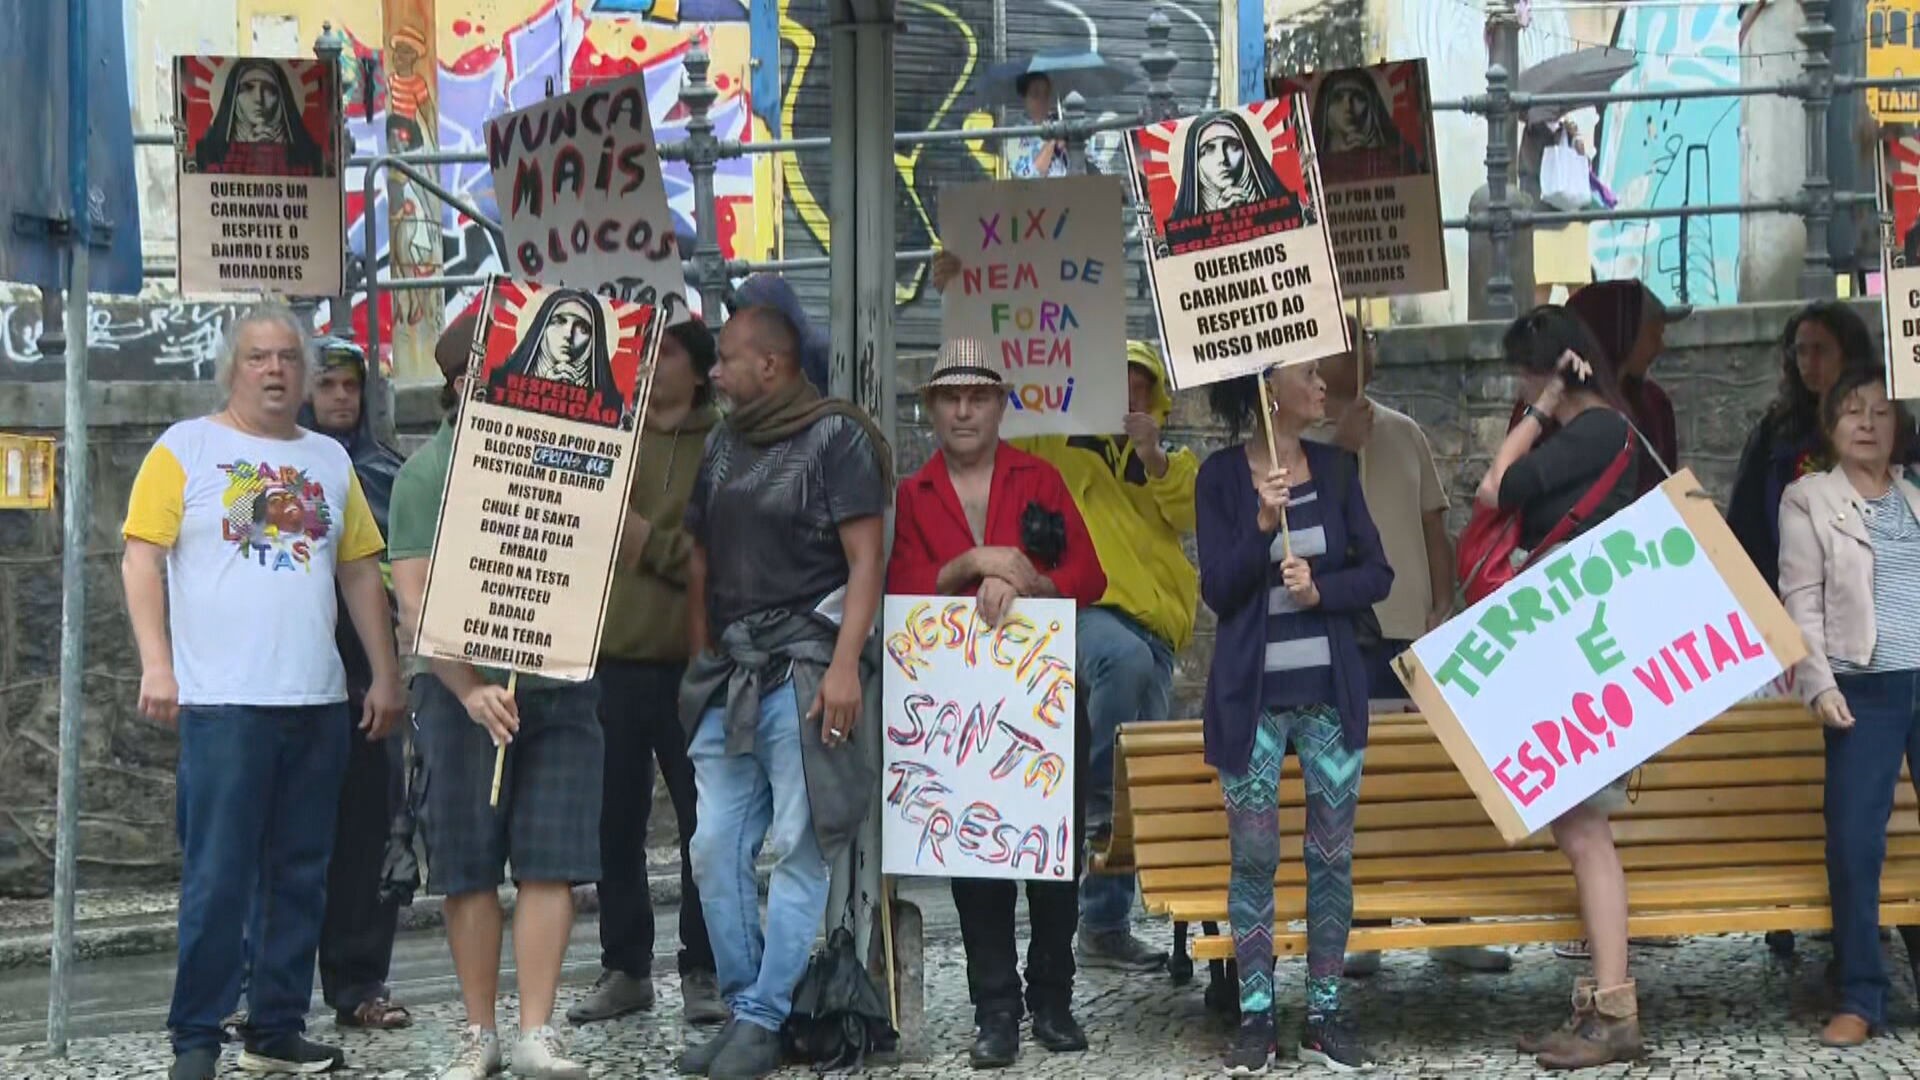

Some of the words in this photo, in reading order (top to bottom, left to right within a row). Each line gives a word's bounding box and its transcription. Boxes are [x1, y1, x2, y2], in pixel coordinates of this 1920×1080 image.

[489, 86, 643, 174] NUNCA
[210, 182, 283, 199] QUEREMOS
[286, 184, 308, 199] UM
[210, 202, 280, 219] CARNAVAL
[283, 205, 309, 220] QUE
[1381, 204, 1407, 222] QUE
[222, 223, 284, 239] RESPEITE
[289, 224, 299, 240] O
[517, 218, 677, 276] BLOCOS
[211, 243, 263, 258] BAIRRO
[266, 245, 273, 259] E
[275, 245, 310, 260] SEUS
[1193, 243, 1288, 282] QUEREMOS
[219, 263, 303, 281] MORADORES
[962, 262, 1039, 296] NEM
[1060, 258, 1104, 284] DE
[1179, 276, 1270, 312] CARNAVAL
[1271, 265, 1312, 291] COM
[990, 300, 1080, 335] FORA
[1196, 300, 1279, 336] RESPEITO
[1282, 295, 1306, 317] AO
[1001, 336, 1072, 370] NEM
[1192, 335, 1254, 364] NOSSO
[1256, 318, 1319, 350] MORRO
[470, 416, 502, 435] TODO
[504, 423, 513, 437] O
[515, 425, 557, 445] NOSSO
[559, 433, 596, 454] APOIO
[597, 441, 622, 459] AOS
[484, 438, 533, 459] BLOCOS
[472, 454, 546, 482] PRESTIGIAM
[548, 469, 557, 483] O
[559, 471, 606, 493] BAIRRO
[507, 482, 563, 506] MISTURA
[482, 498, 520, 518] CHULÉ
[525, 506, 540, 522] DE
[542, 510, 581, 529] SANTA
[480, 518, 521, 540] BONDE
[522, 525, 539, 542] DA
[541, 531, 574, 549] FOLIA
[499, 541, 548, 564] EMBALO
[469, 556, 514, 577] CHEIRO
[515, 562, 533, 581] NA
[536, 568, 571, 588] TESTA
[480, 579, 551, 605] ACONTECEU
[488, 601, 536, 623] BADALO
[463, 618, 490, 637] CÉU
[490, 624, 509, 641] NA
[1575, 599, 1627, 676] É
[463, 641, 545, 669] CARMELITAS
[1493, 682, 1633, 808] ESPAÇO
[1632, 611, 1765, 707] VITAL
[887, 694, 1065, 800] SANTA
[887, 760, 1068, 877] TERESA!
